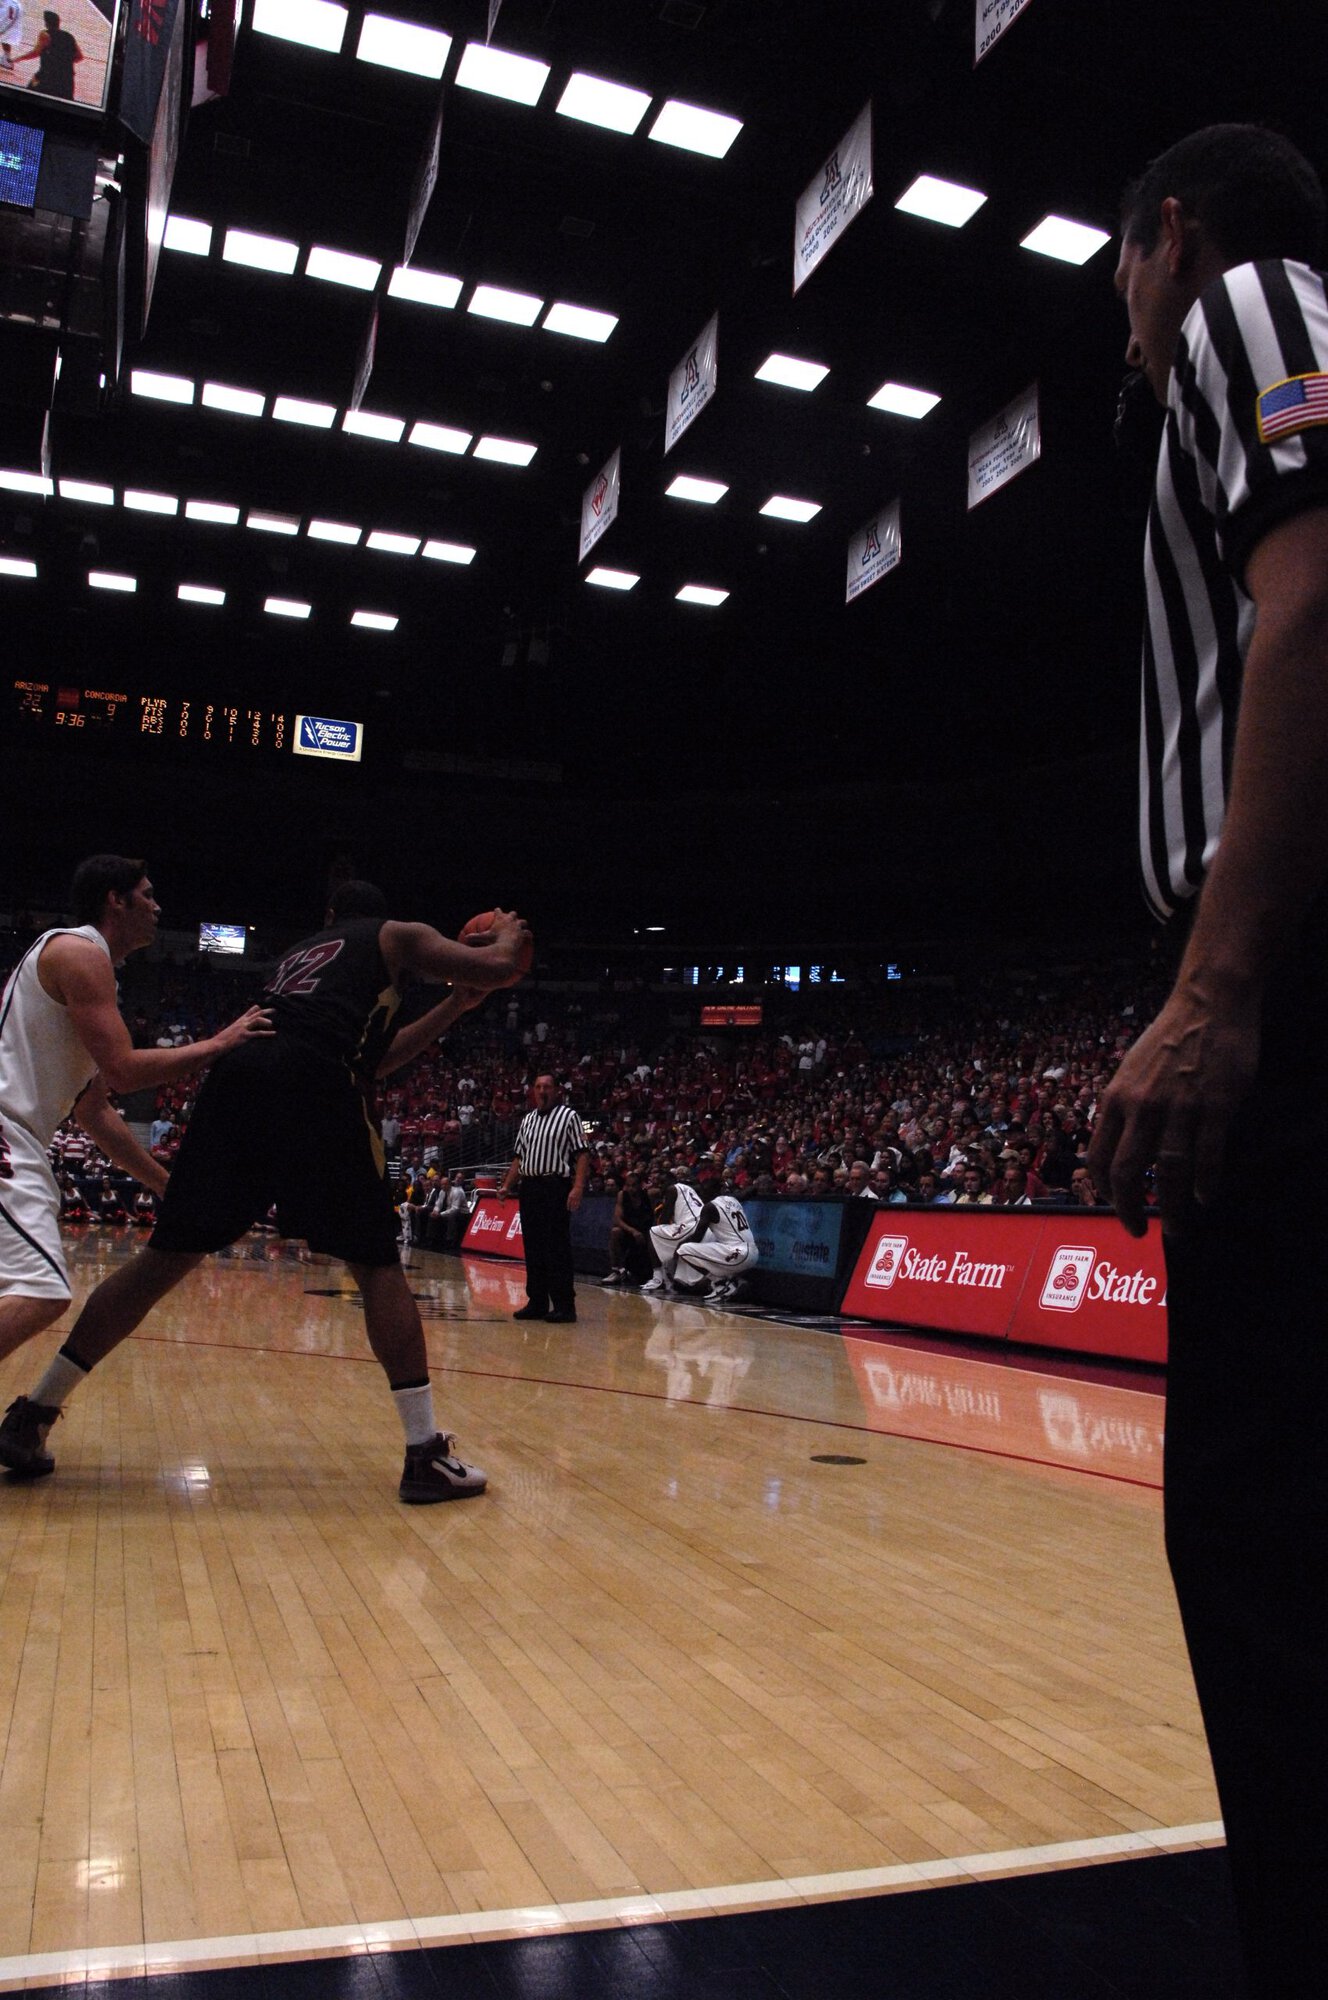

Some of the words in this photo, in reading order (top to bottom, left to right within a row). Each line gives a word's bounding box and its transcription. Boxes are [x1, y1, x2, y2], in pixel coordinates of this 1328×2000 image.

[980, 22, 1001, 53] 2000
[14, 680, 49, 693] ARIZONA
[84, 689, 128, 703] CONCORDIA
[107, 703, 116, 716] 9
[141, 697, 167, 709] PLYR
[182, 702, 191, 711] 7
[224, 707, 238, 717] 10
[144, 706, 163, 717] PTS
[55, 712, 86, 728] 9:36
[142, 715, 164, 725] RBS
[315, 721, 346, 733] Tucson
[141, 723, 163, 734] FLS
[317, 729, 352, 741] Electric
[319, 738, 351, 748] Power
[731, 1210, 749, 1233] 20
[792, 1241, 830, 1264] Allstate
[898, 1248, 947, 1283] State
[945, 1251, 1007, 1289] Farm
[1087, 1261, 1157, 1305] State
[1045, 1293, 1077, 1302] INSURANCE
